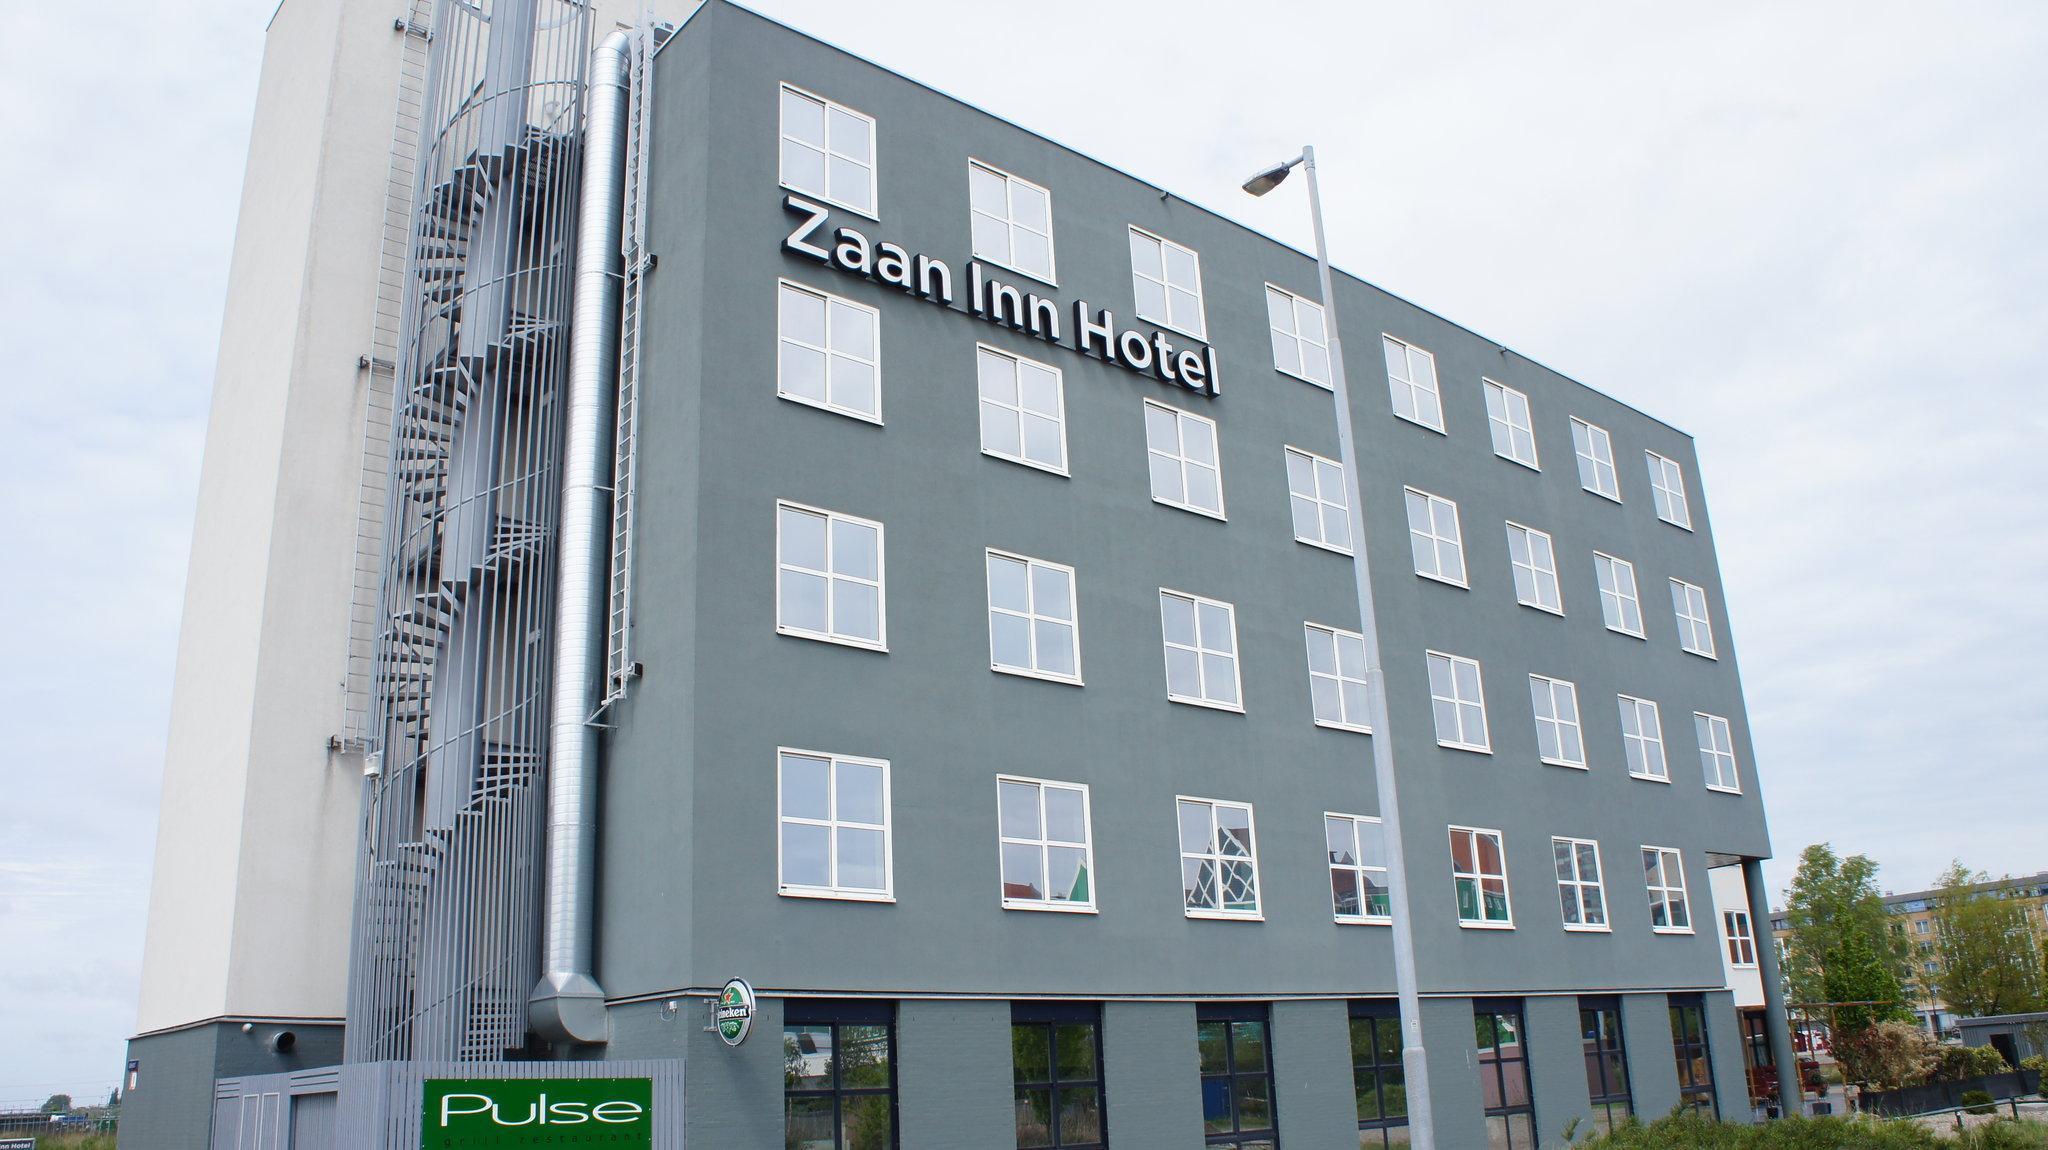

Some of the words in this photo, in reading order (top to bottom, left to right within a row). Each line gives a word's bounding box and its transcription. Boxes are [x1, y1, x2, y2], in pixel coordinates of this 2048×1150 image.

[782, 195, 953, 306] Zaan
[966, 261, 1060, 343] Inn
[1073, 299, 1221, 398] Hotel
[440, 1093, 643, 1127] Pulse
[443, 1135, 500, 1148] grill
[519, 1132, 643, 1145] restaurant
